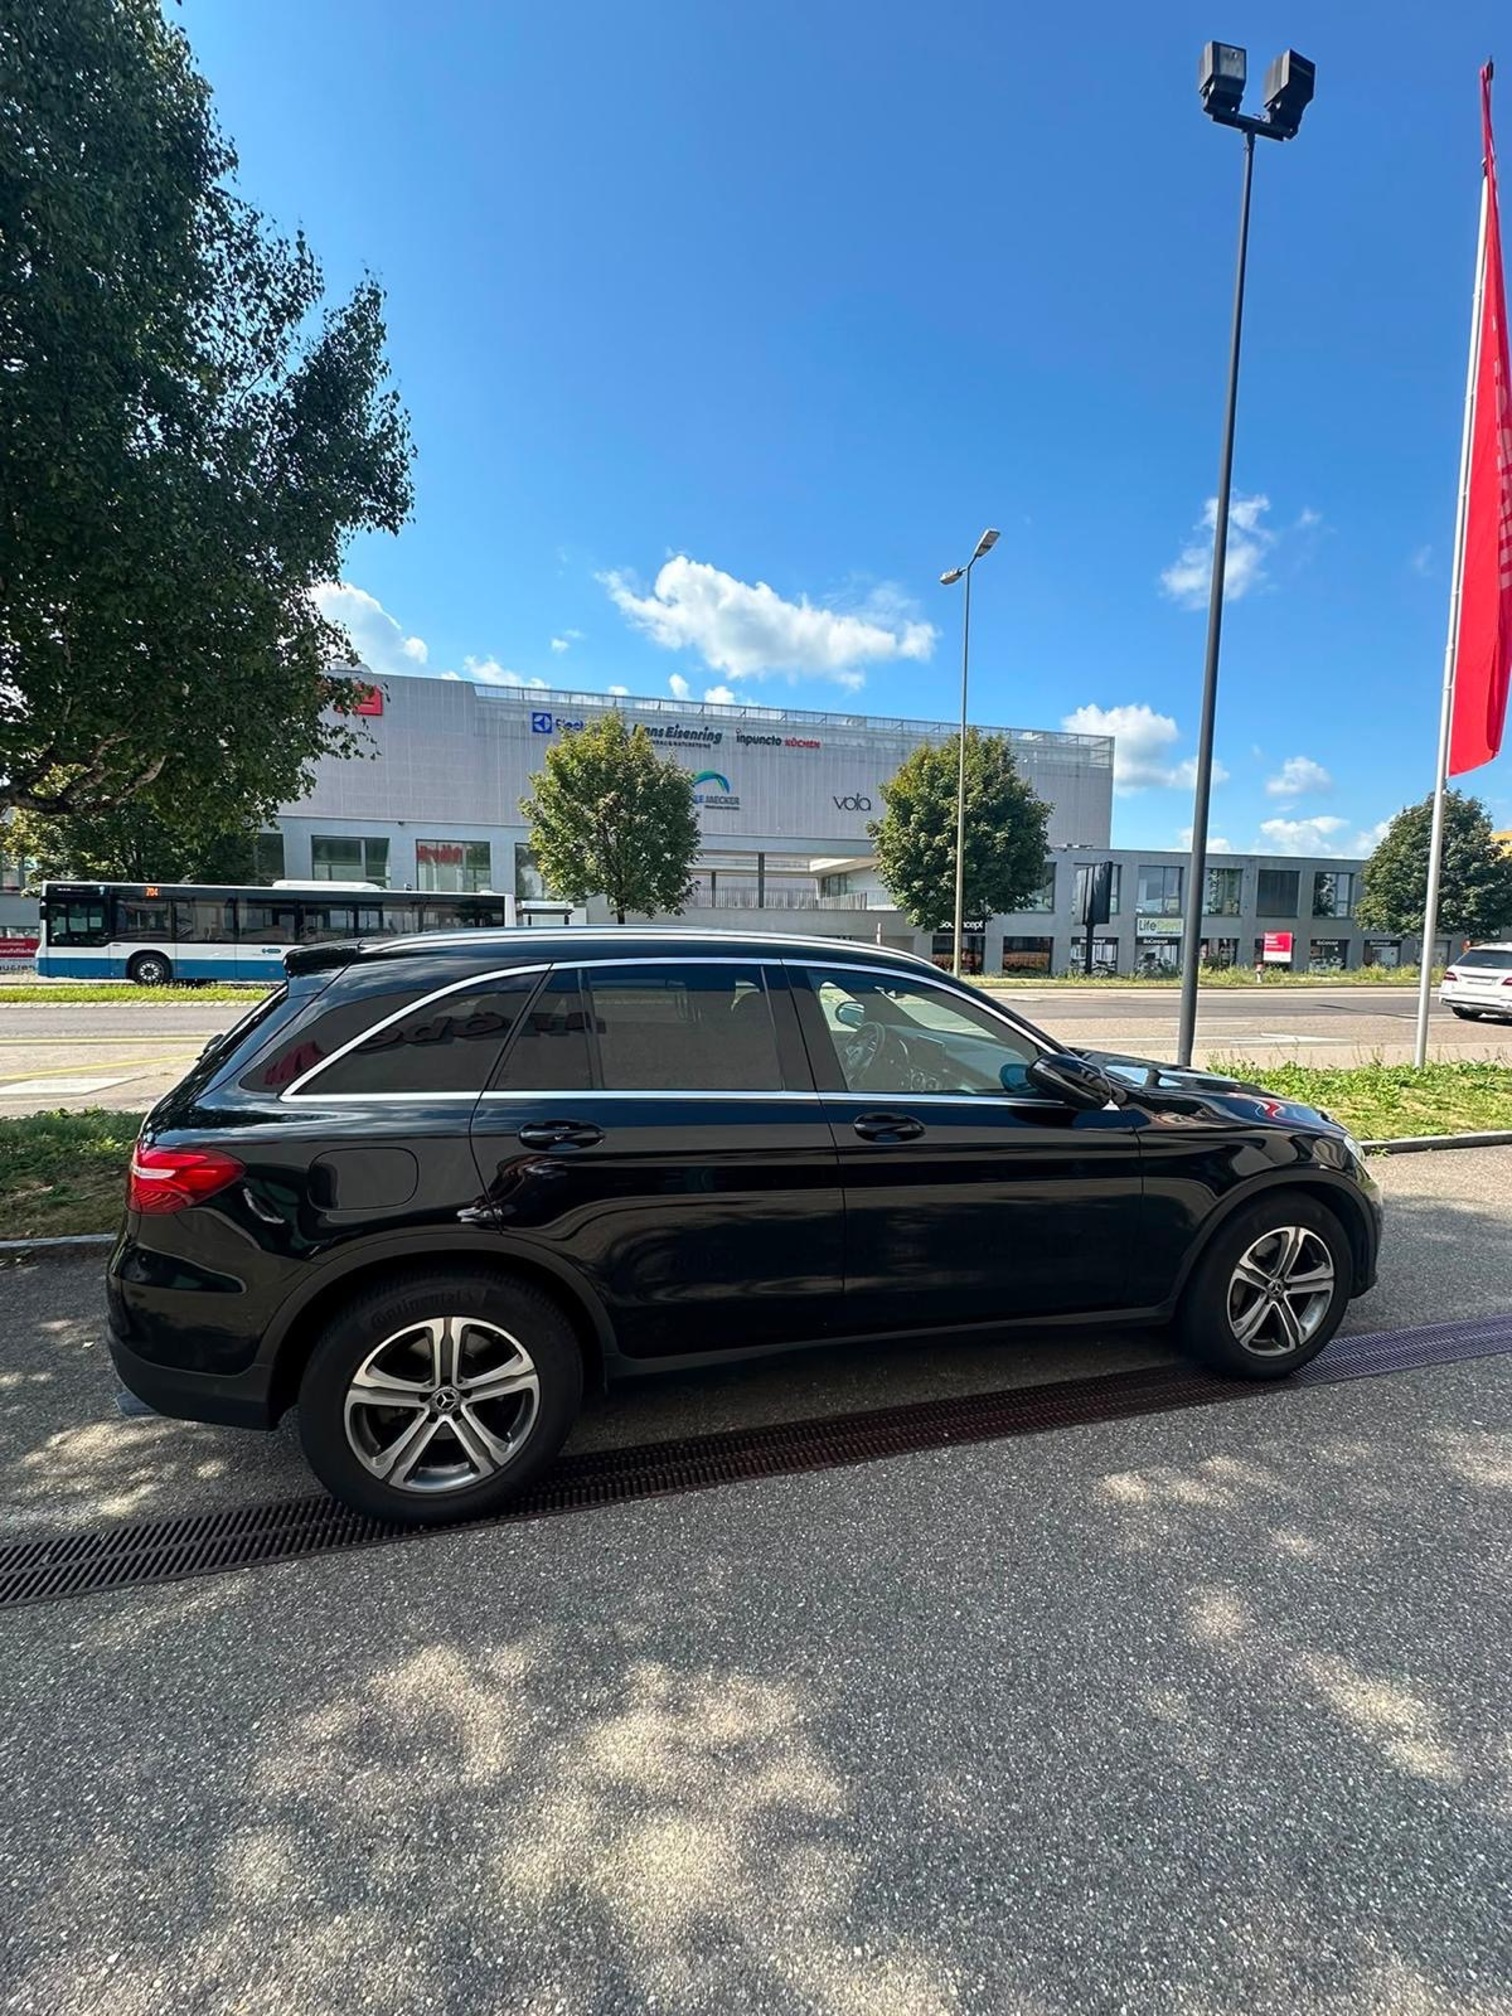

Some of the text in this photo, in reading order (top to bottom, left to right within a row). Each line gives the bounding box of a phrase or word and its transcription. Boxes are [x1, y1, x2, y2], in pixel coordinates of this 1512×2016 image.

[665, 723, 722, 744] Eisenring
[736, 728, 782, 746] inpuncto
[833, 793, 872, 811] vola
[146, 887, 159, 897] 704
